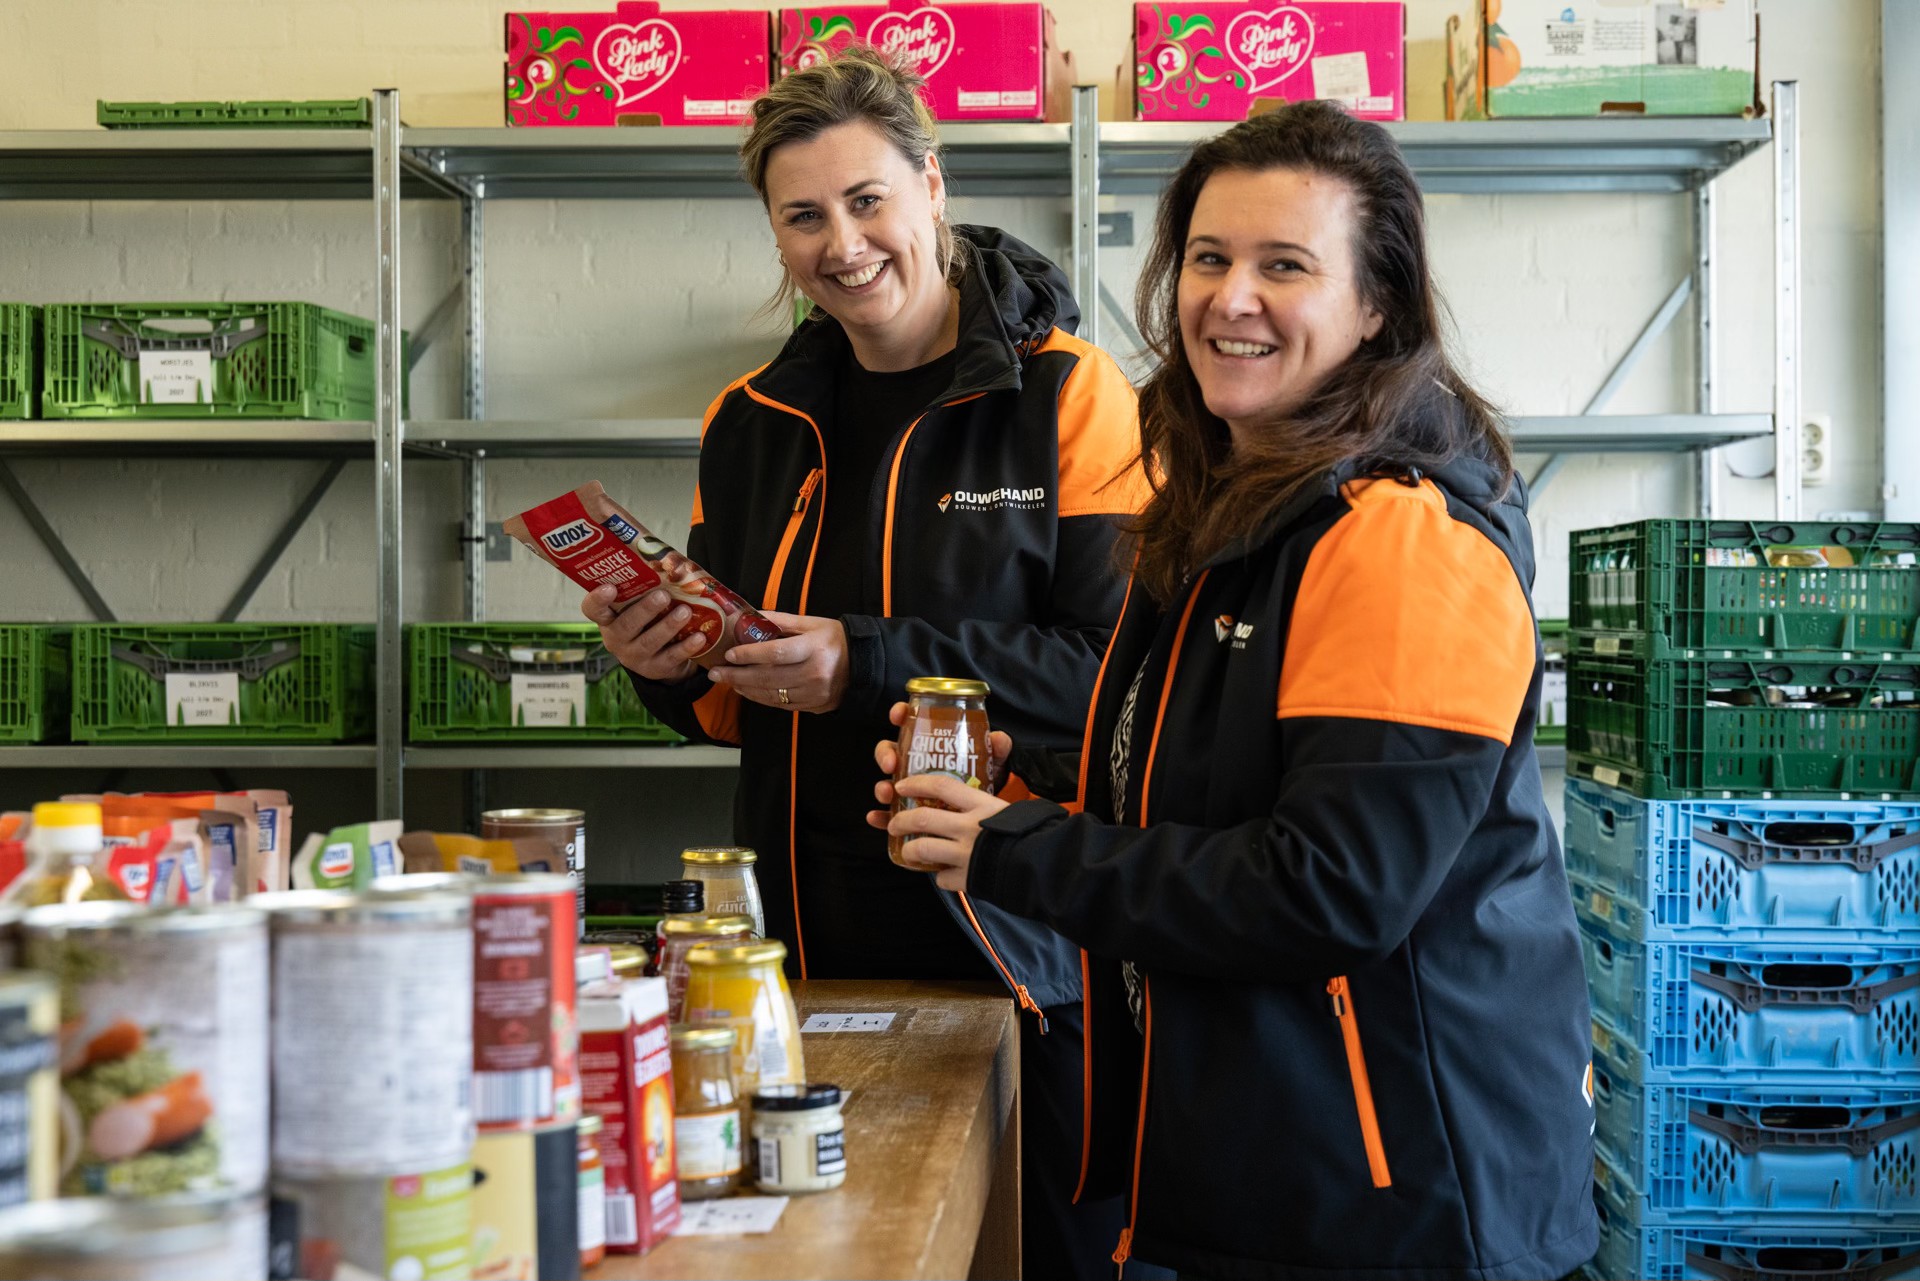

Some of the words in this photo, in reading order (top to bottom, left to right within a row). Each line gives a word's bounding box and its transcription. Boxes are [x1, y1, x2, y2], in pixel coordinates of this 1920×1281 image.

[607, 27, 665, 67] Pink
[881, 15, 938, 53] Pink
[1239, 15, 1297, 53] Pink
[616, 50, 669, 84] Lady
[1248, 37, 1301, 70] Lady
[954, 487, 1045, 504] OUWEHAND
[994, 501, 1045, 510] ONTWIKKELEN
[577, 549, 633, 581] KLASSIEKE
[912, 735, 975, 754] CHICKN
[933, 728, 953, 737] EASY
[908, 751, 979, 776] TONIGHT
